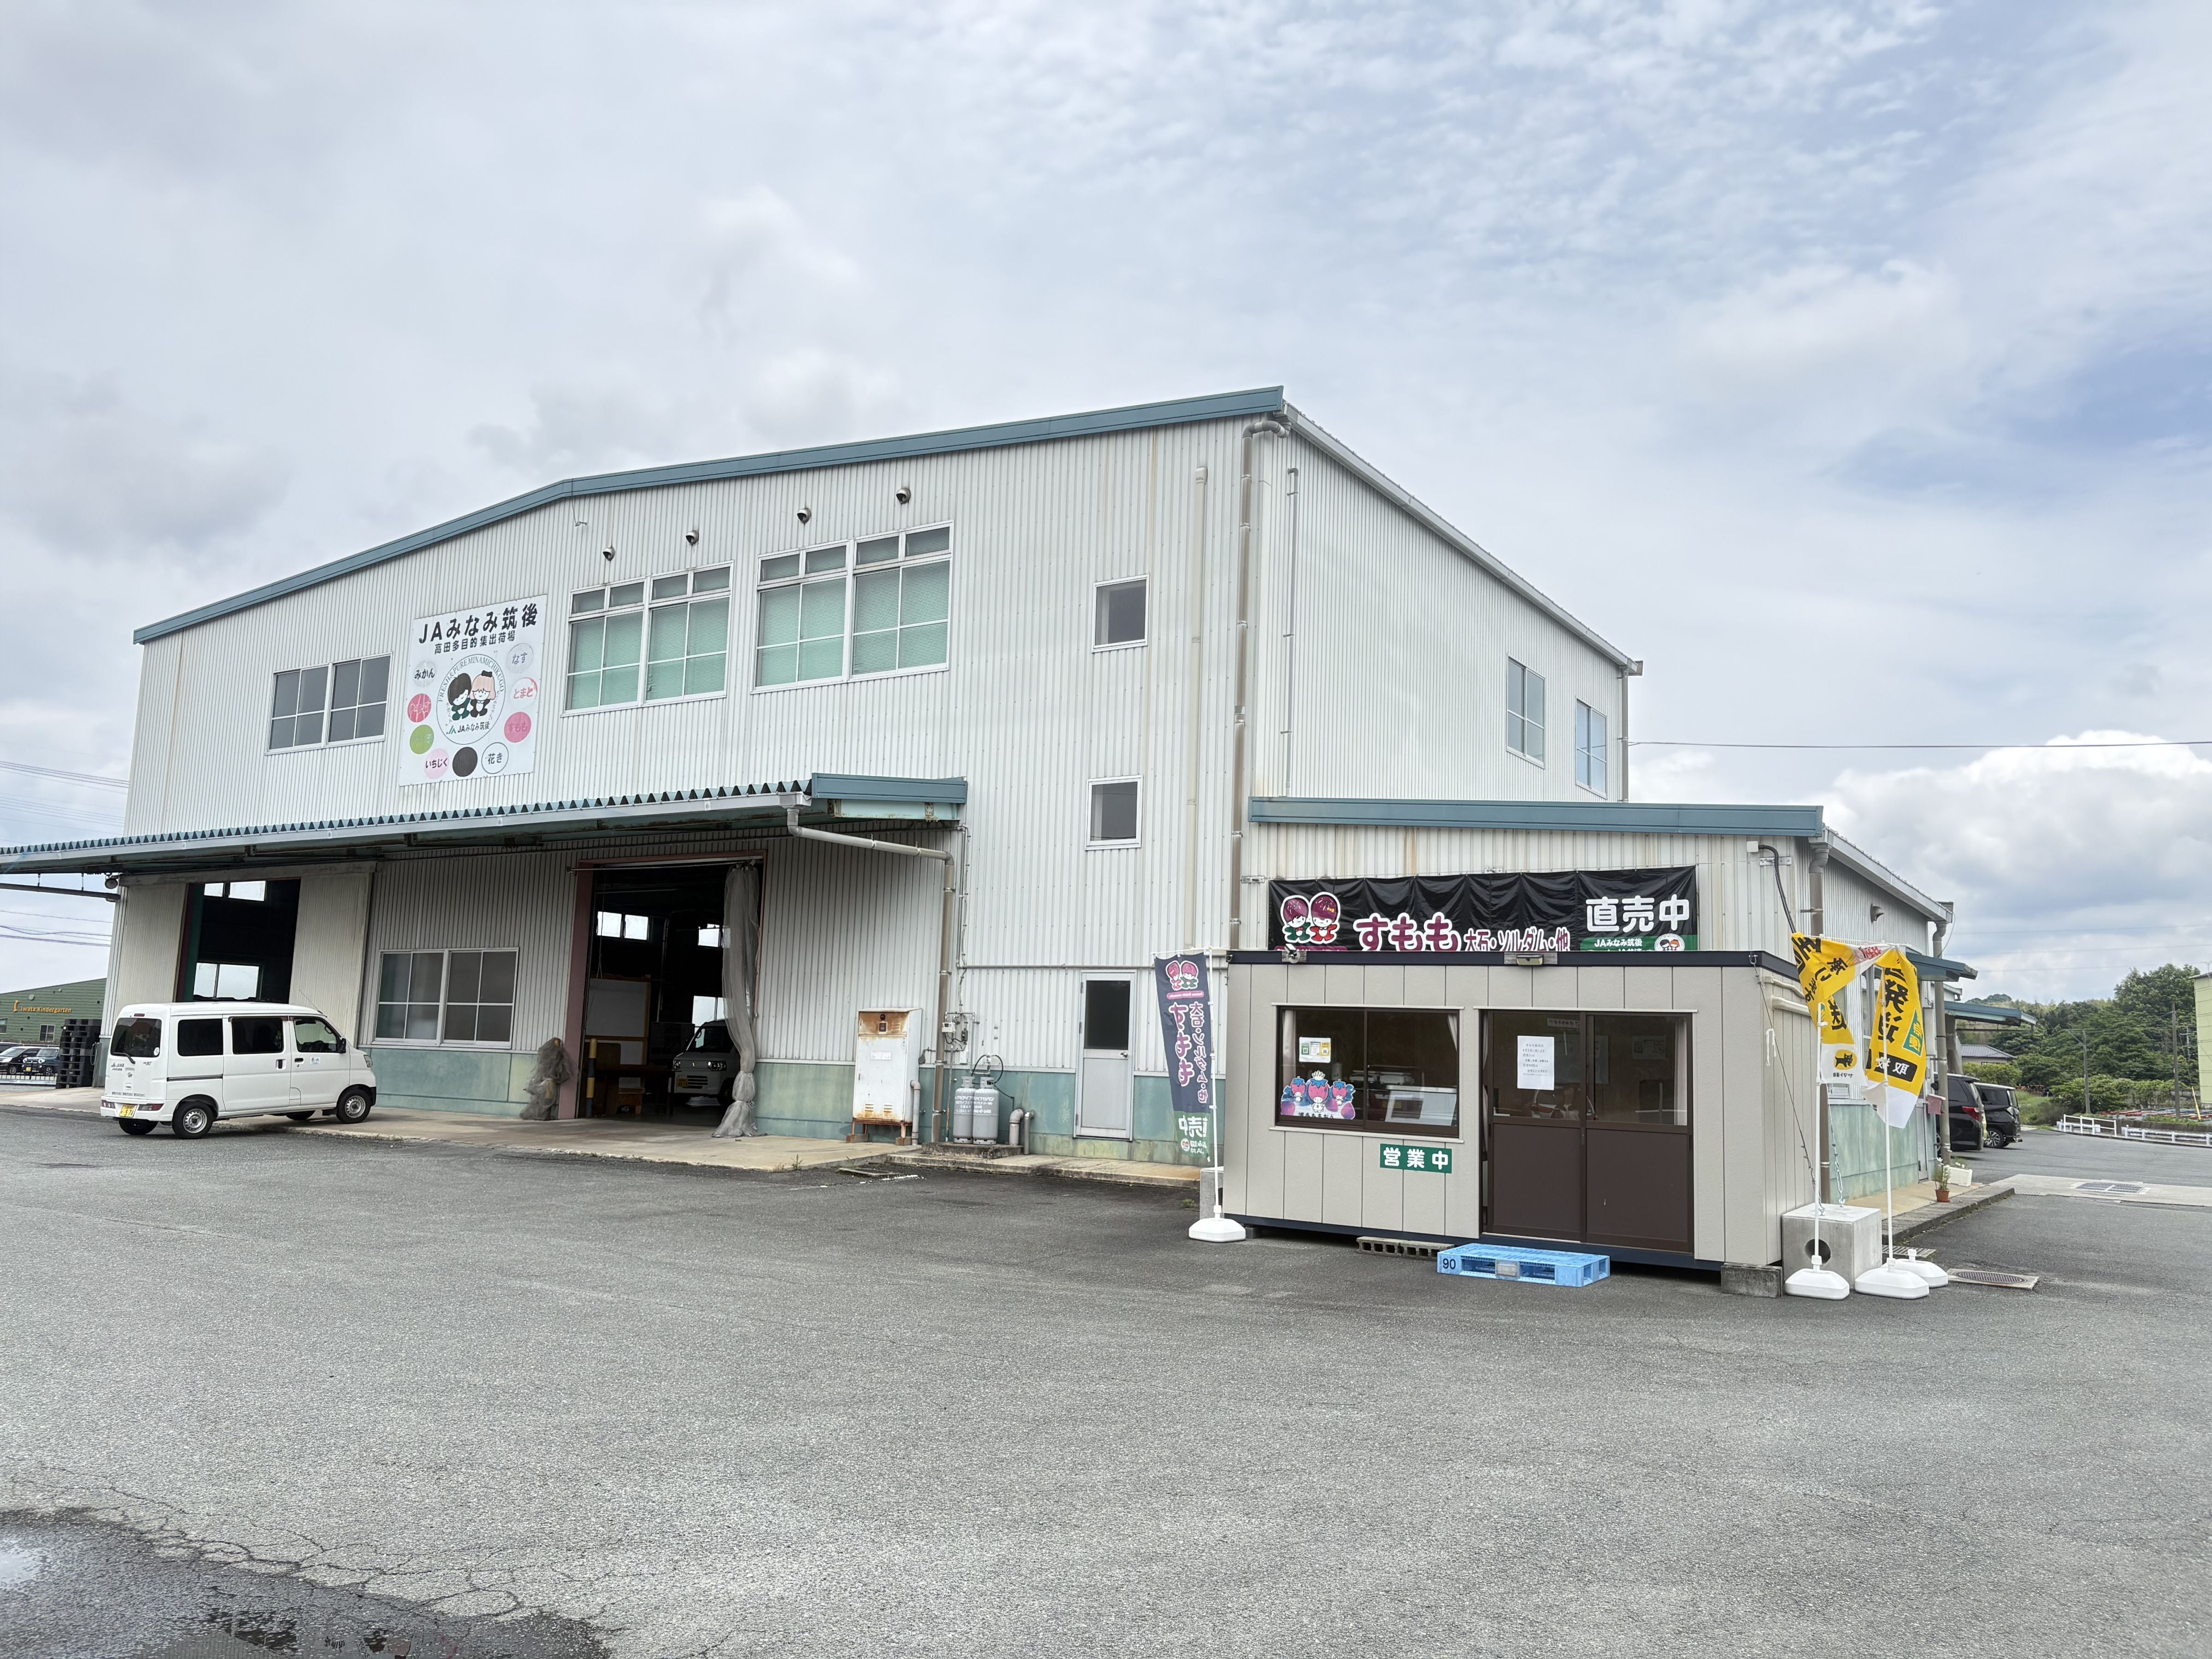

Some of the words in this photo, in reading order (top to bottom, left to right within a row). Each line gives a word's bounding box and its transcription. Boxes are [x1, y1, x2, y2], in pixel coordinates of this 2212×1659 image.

[418, 603, 538, 644] JAみなみ筑後
[435, 630, 516, 654] 高田多目的集出荷場
[512, 653, 527, 665] なす
[414, 668, 435, 680] みかん
[513, 687, 533, 699] とまと
[508, 721, 528, 733] すもも
[426, 758, 447, 769] いちじく
[488, 753, 503, 765] 花き
[1586, 894, 1689, 933] 直売中
[1353, 912, 1462, 951] すもも
[1594, 938, 1642, 947] JAみなみ筑後
[1383, 1147, 1448, 1170] 営業中
[1442, 1258, 1456, 1270] 90
